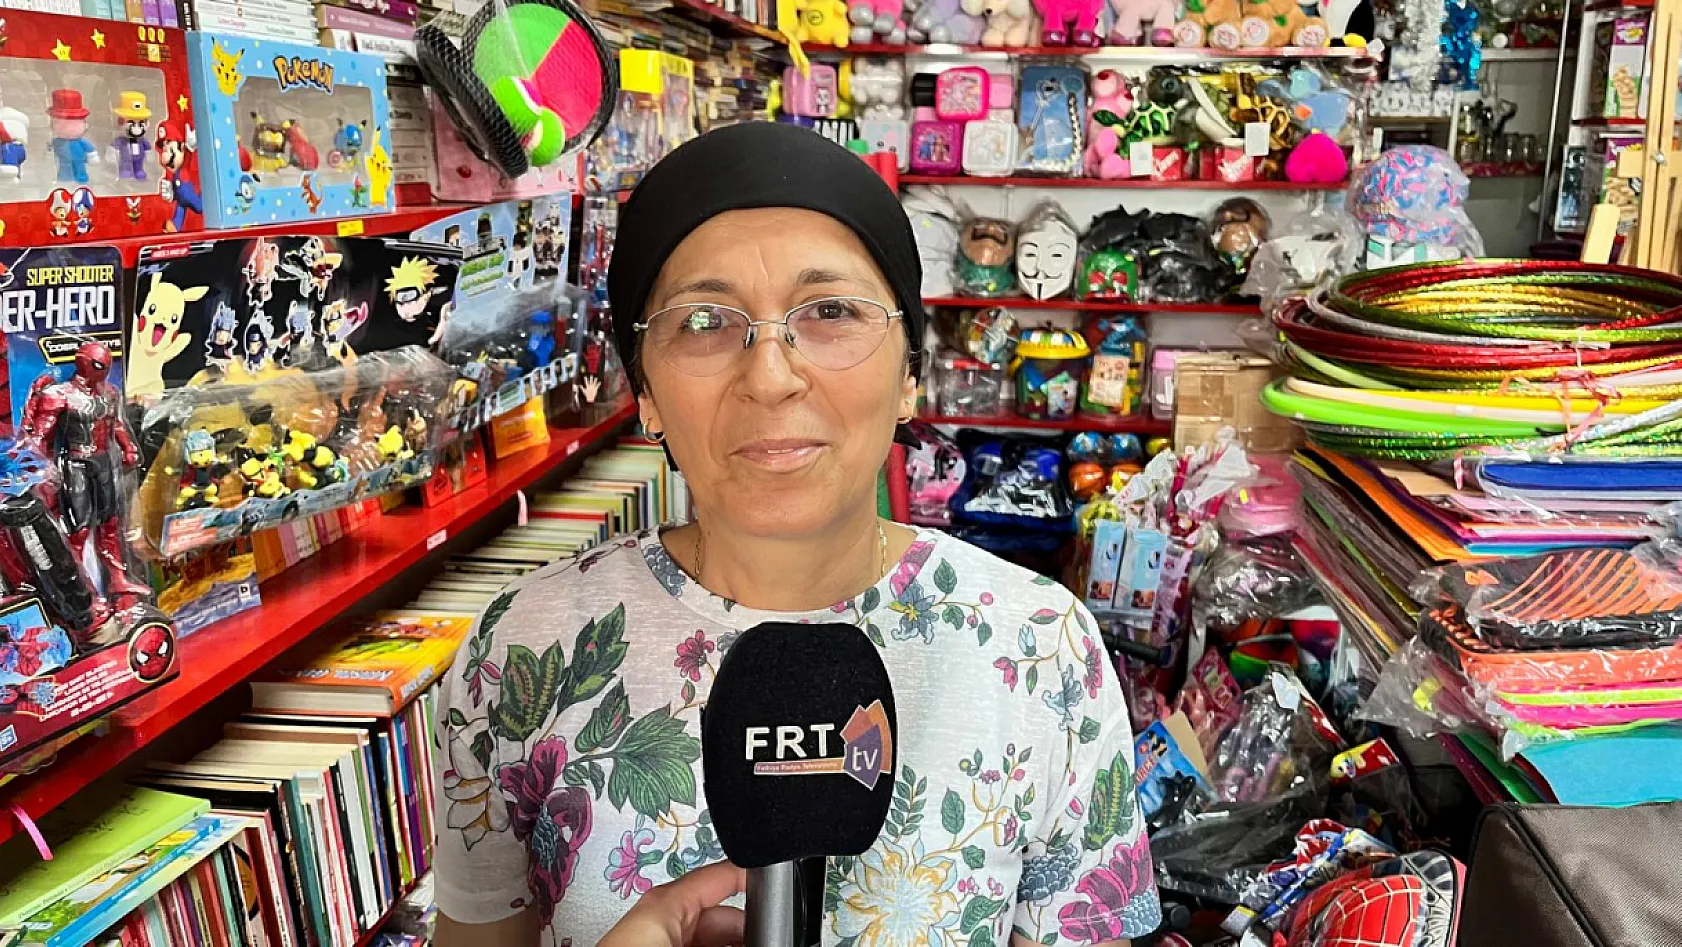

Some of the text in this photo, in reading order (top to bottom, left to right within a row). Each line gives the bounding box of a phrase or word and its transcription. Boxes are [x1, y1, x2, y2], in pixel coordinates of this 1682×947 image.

[26, 265, 114, 286] SUPER SHOOTER
[0, 286, 115, 333] ER-HERO
[746, 723, 878, 771] FRT tv
